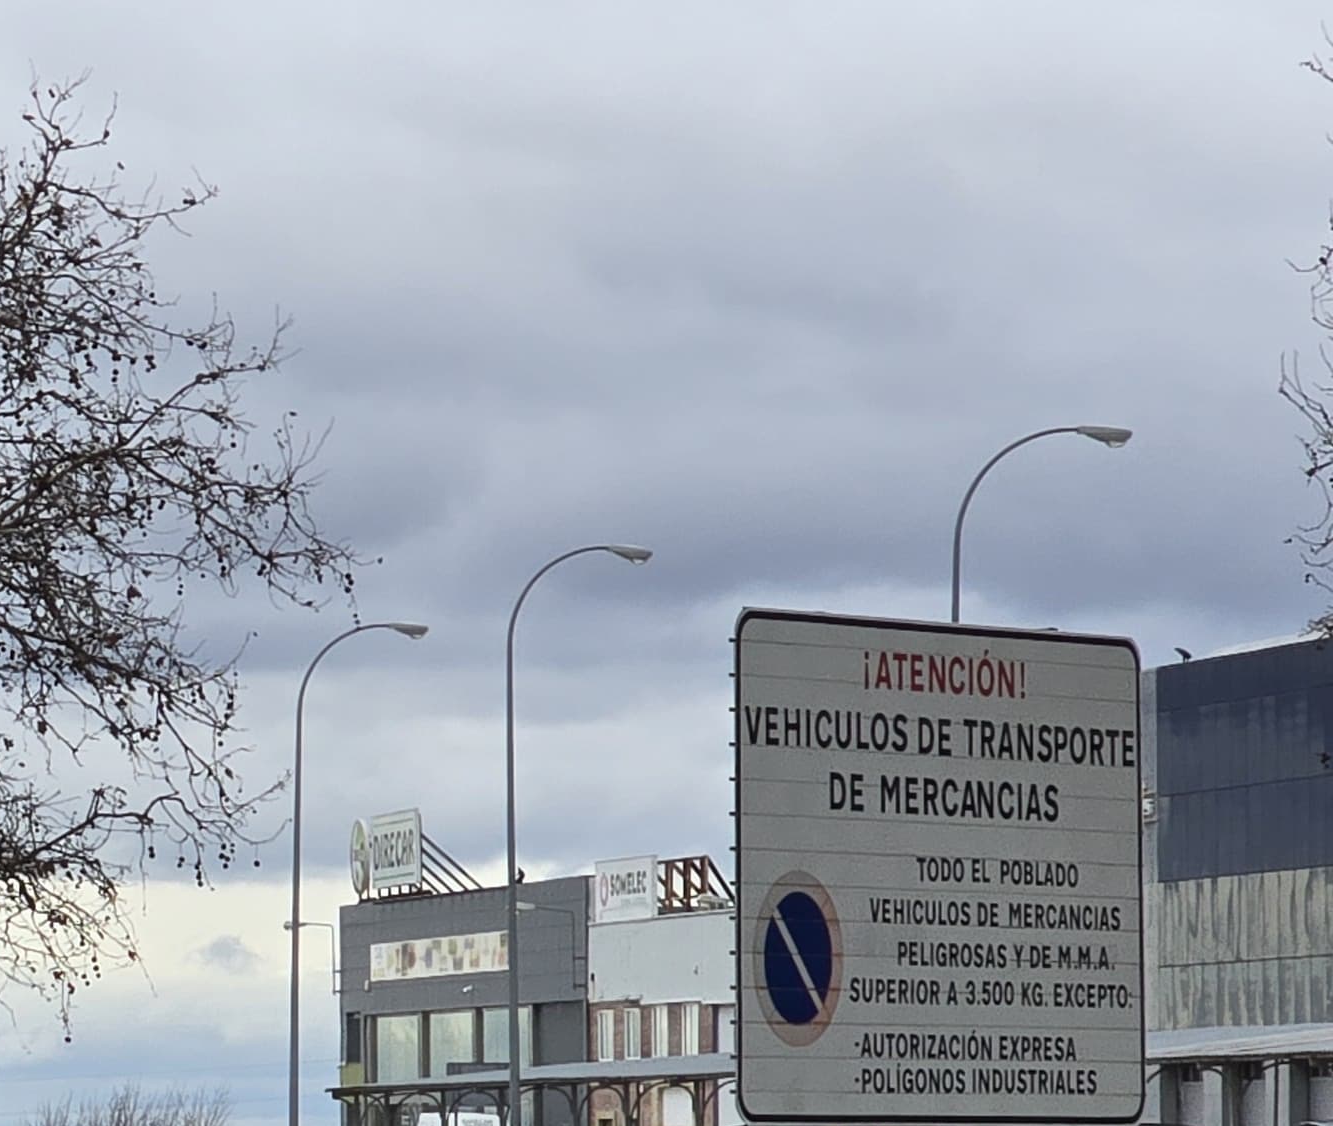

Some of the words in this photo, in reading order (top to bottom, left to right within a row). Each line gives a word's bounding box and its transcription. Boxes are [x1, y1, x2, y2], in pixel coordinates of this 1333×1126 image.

[864, 649, 1026, 699] ¡ATENCIÓN!
[745, 705, 908, 752] VEHICULOS
[919, 718, 952, 757] DE
[963, 719, 1134, 767] TRANSPORTE
[829, 771, 864, 811] DE
[881, 774, 1059, 822] MERCANCIAS
[916, 857, 964, 883] TODO
[972, 859, 990, 884] EL
[1000, 859, 1079, 888] POBLADO
[870, 898, 970, 927] VEHICULOS
[977, 902, 1000, 927] DE
[1008, 903, 1120, 931] MERCANCIAS
[897, 941, 1007, 968] PELIGROSAS
[1013, 944, 1023, 969] Y
[1029, 945, 1051, 969] DE
[1058, 945, 1115, 970] M.M.A.
[849, 978, 939, 1005] SUPERIOR
[947, 981, 958, 1005] A
[965, 981, 1014, 1006] 3.500
[1021, 982, 1048, 1007] KG.
[1054, 983, 1133, 1009] EXCEPTO:
[999, 1036, 1077, 1061] EXPRESA
[972, 1070, 1097, 1095] INDUSTRIALES
